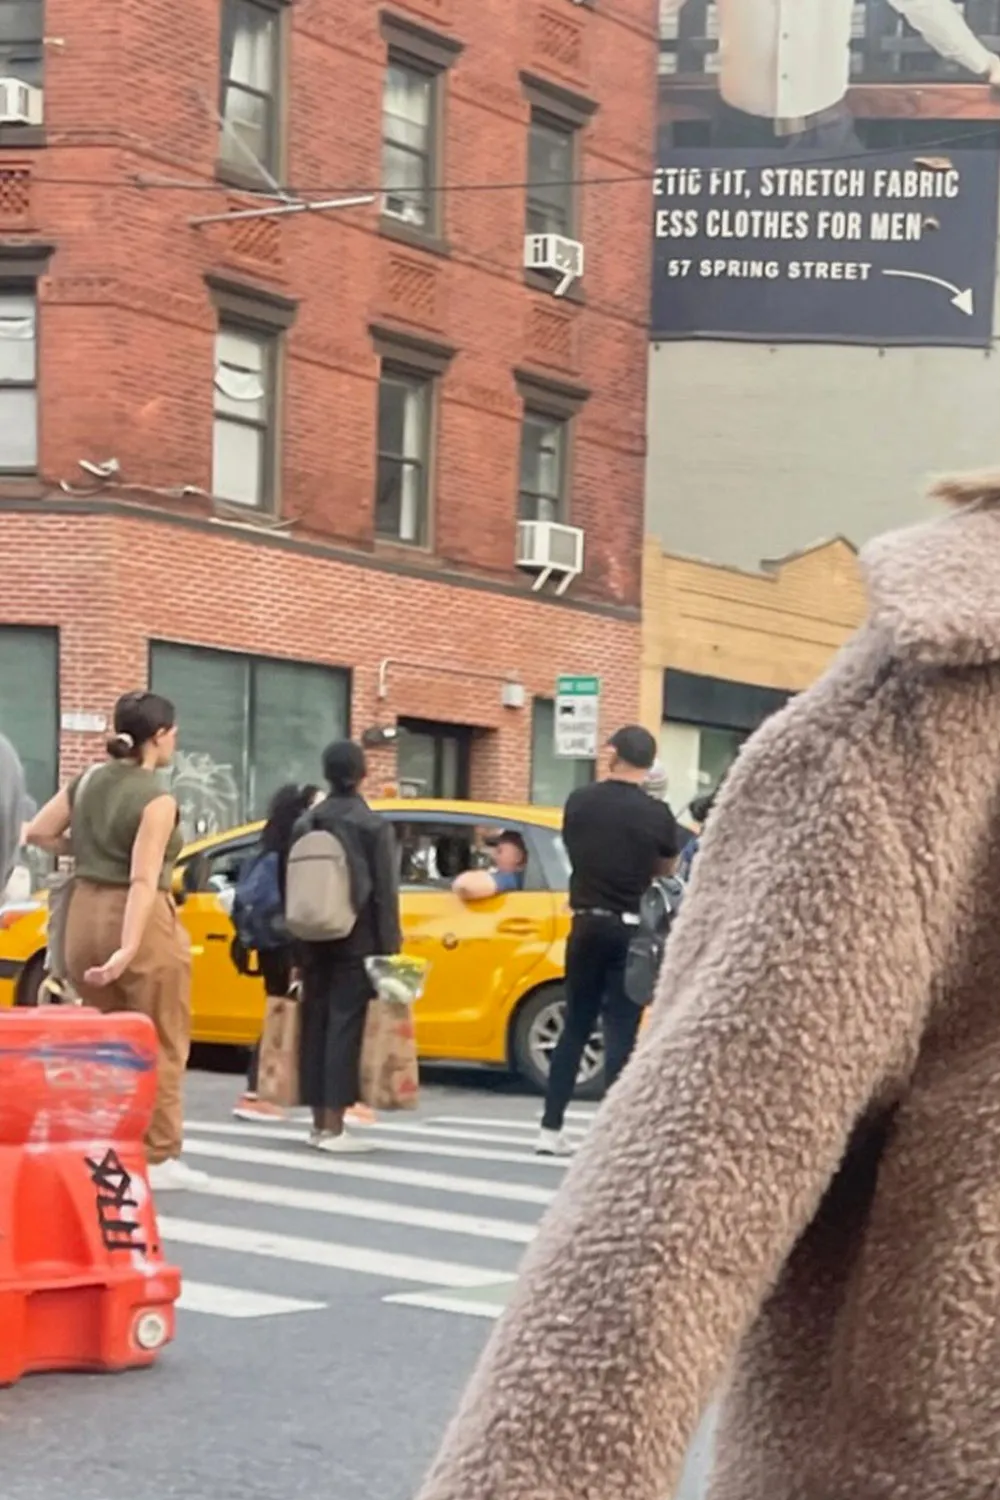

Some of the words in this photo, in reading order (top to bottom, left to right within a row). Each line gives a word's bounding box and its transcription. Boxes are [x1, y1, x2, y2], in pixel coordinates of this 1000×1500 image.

[710, 167, 751, 199] FIT,
[760, 168, 864, 198] STRETCH
[874, 169, 959, 198] FABRIC
[656, 209, 698, 238] ESS
[706, 209, 809, 239] CLOTHES
[817, 211, 862, 240] FOR
[870, 212, 921, 241] MEN
[667, 260, 691, 277] 57
[700, 260, 779, 279] SPRING
[788, 262, 872, 280] STREET
